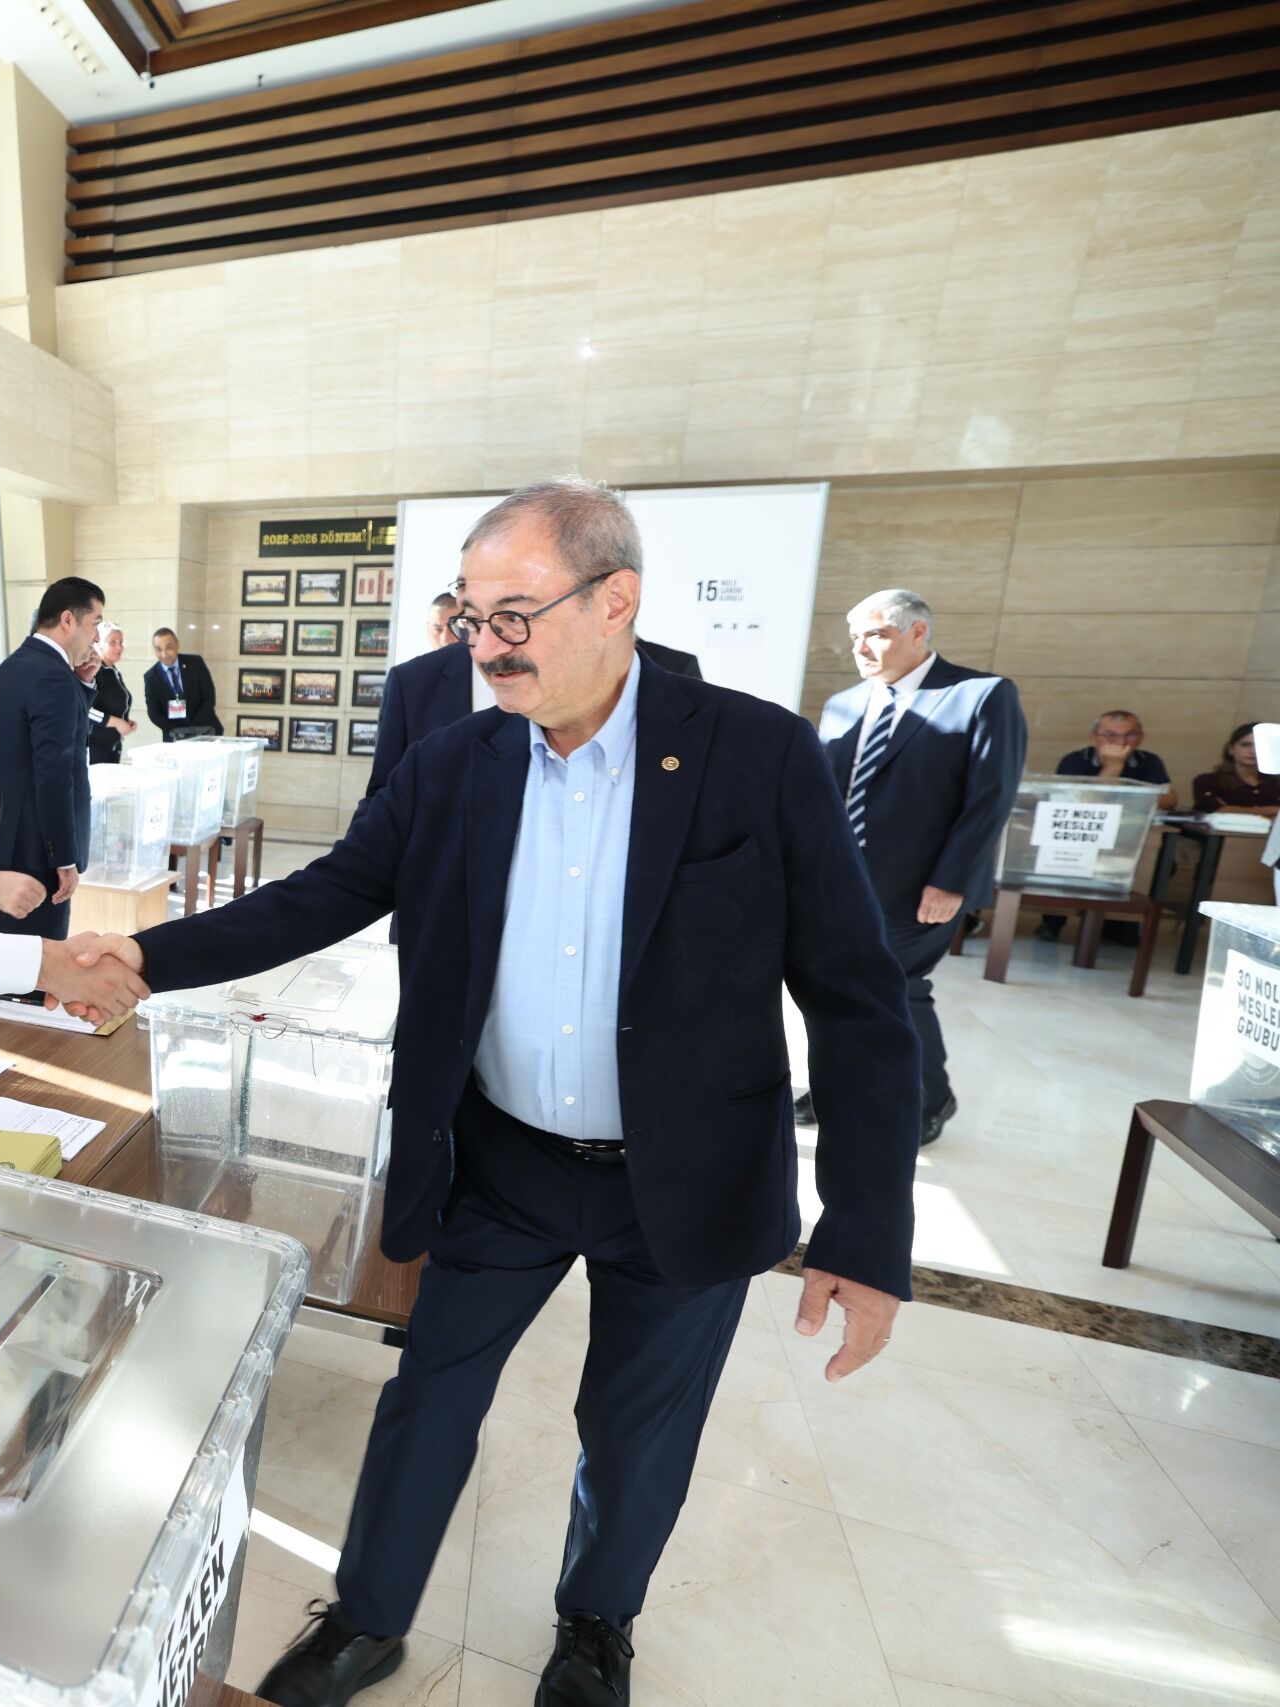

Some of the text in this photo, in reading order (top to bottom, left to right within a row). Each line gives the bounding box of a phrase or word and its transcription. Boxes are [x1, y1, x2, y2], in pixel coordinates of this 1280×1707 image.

[262, 533, 318, 545] 2022-2026
[696, 580, 718, 602] 15
[1052, 808, 1108, 821] 27 NOLU
[1051, 820, 1105, 831] MESLEK
[1053, 832, 1099, 842] GRUBU
[1237, 969, 1280, 1004] 30 NOL
[1237, 991, 1280, 1029] MESLE
[1237, 1016, 1280, 1052] GRUBU
